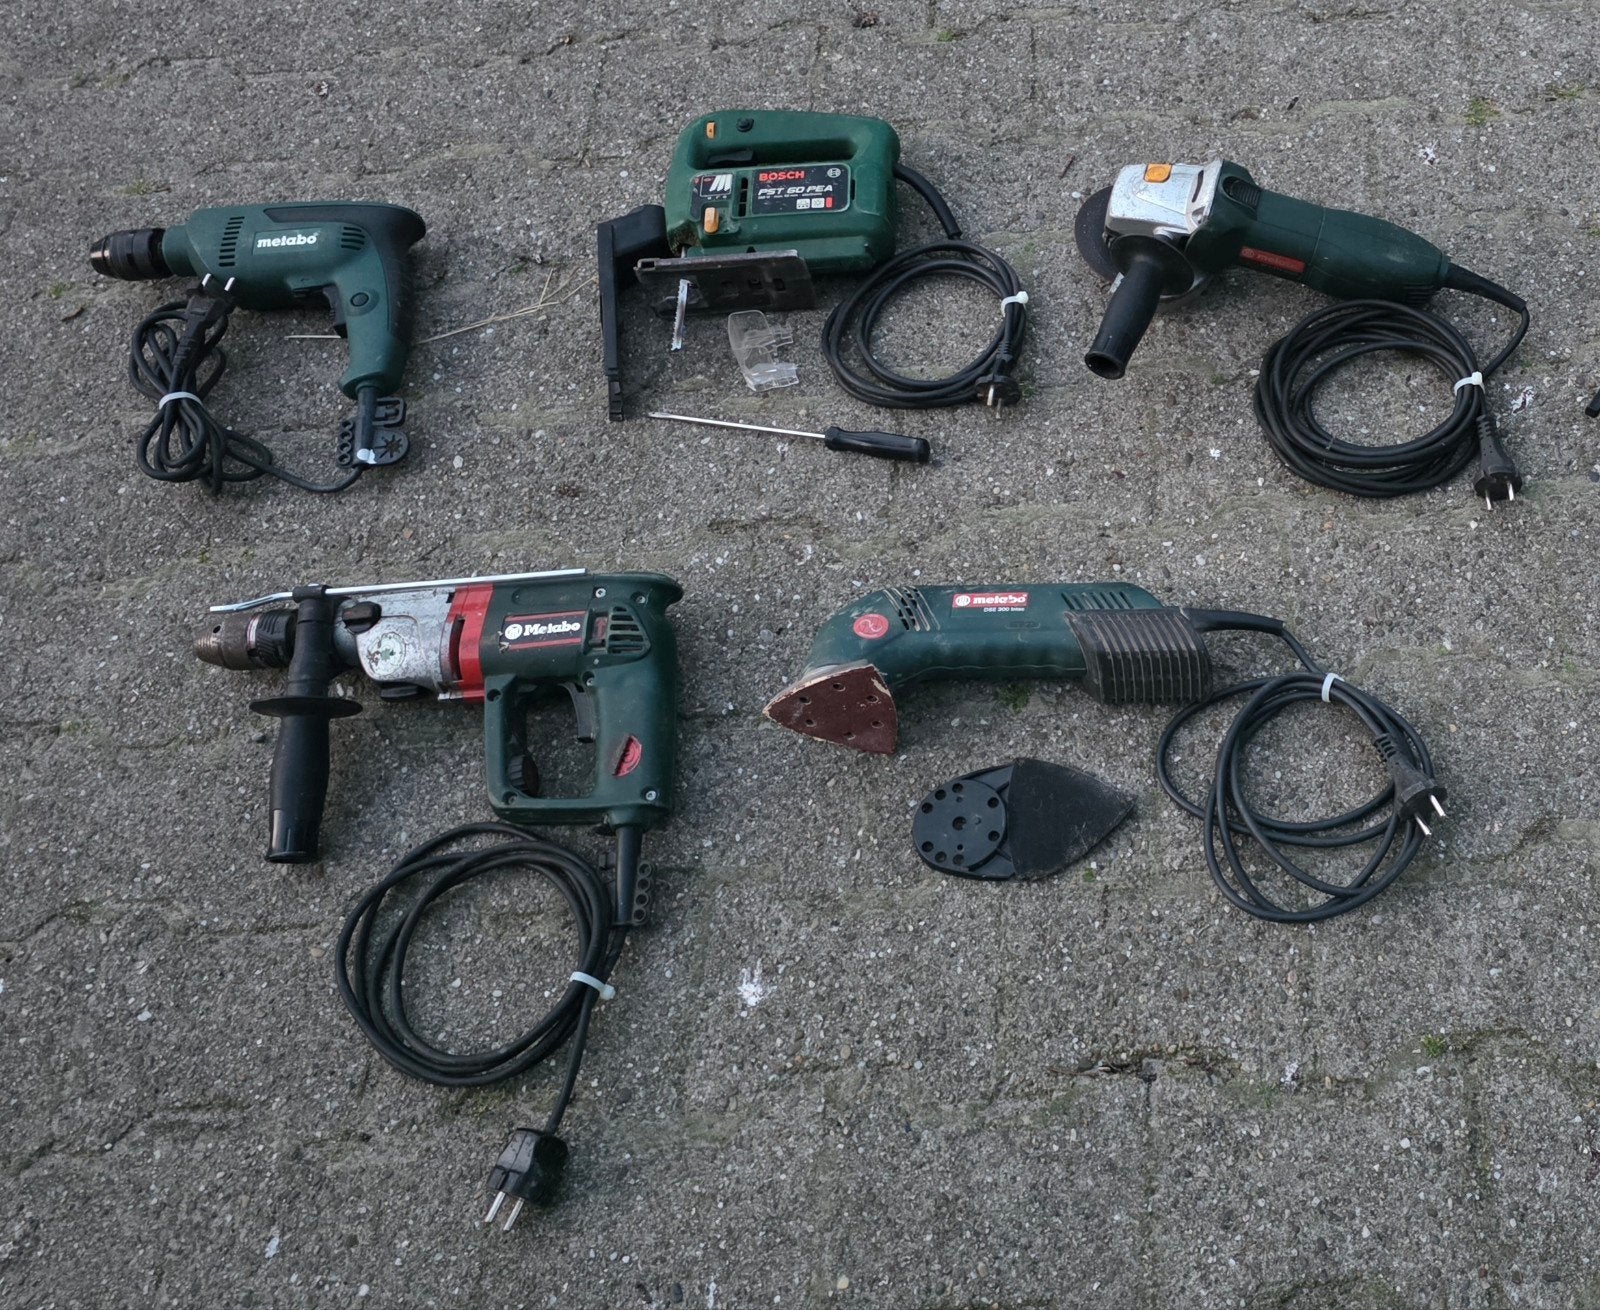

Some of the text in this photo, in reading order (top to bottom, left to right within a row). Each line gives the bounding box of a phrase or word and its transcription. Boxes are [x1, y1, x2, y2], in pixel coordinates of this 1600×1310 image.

[759, 170, 805, 182] BOSCH
[758, 187, 785, 196] PST
[787, 186, 805, 194] 60
[806, 184, 833, 193] PEA
[256, 233, 318, 248] metabo
[972, 594, 1026, 605] metabo
[523, 620, 581, 636] Metabo
